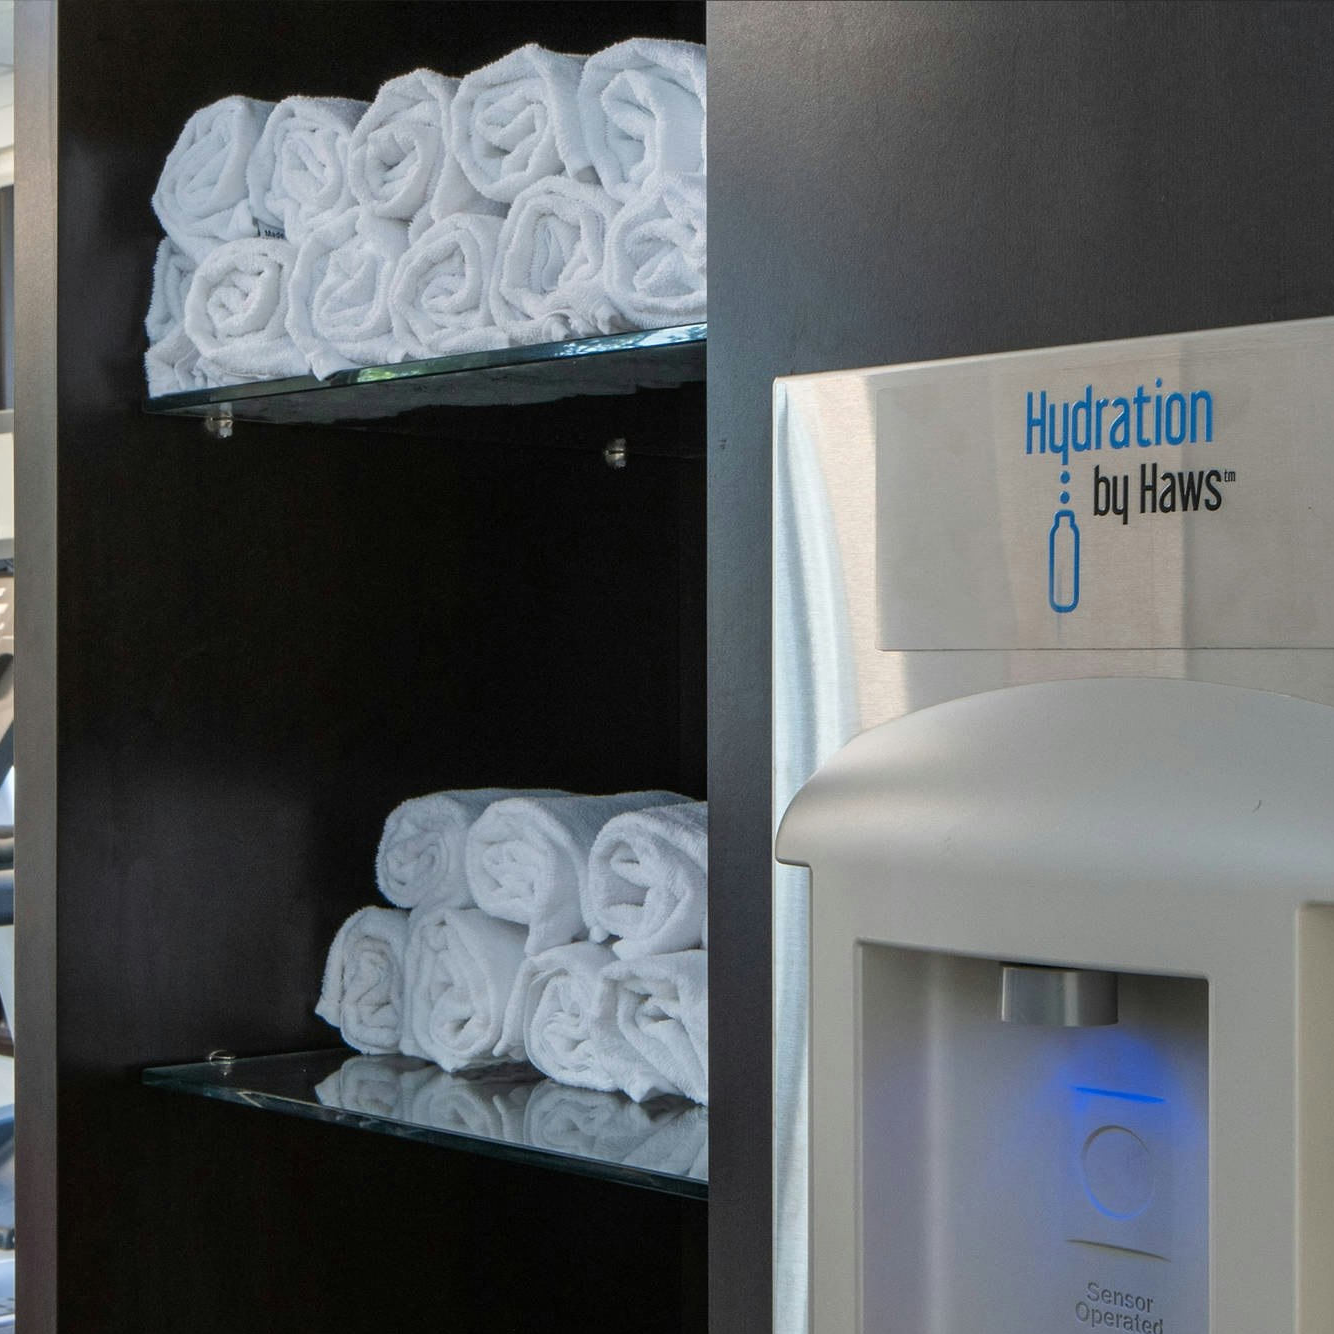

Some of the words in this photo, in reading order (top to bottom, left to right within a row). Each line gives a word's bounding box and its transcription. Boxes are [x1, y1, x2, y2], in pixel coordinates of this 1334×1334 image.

[1025, 377, 1214, 466] Hydration
[1093, 464, 1129, 525] by
[1139, 462, 1223, 514] Haws
[1086, 1281, 1154, 1314] Sensor
